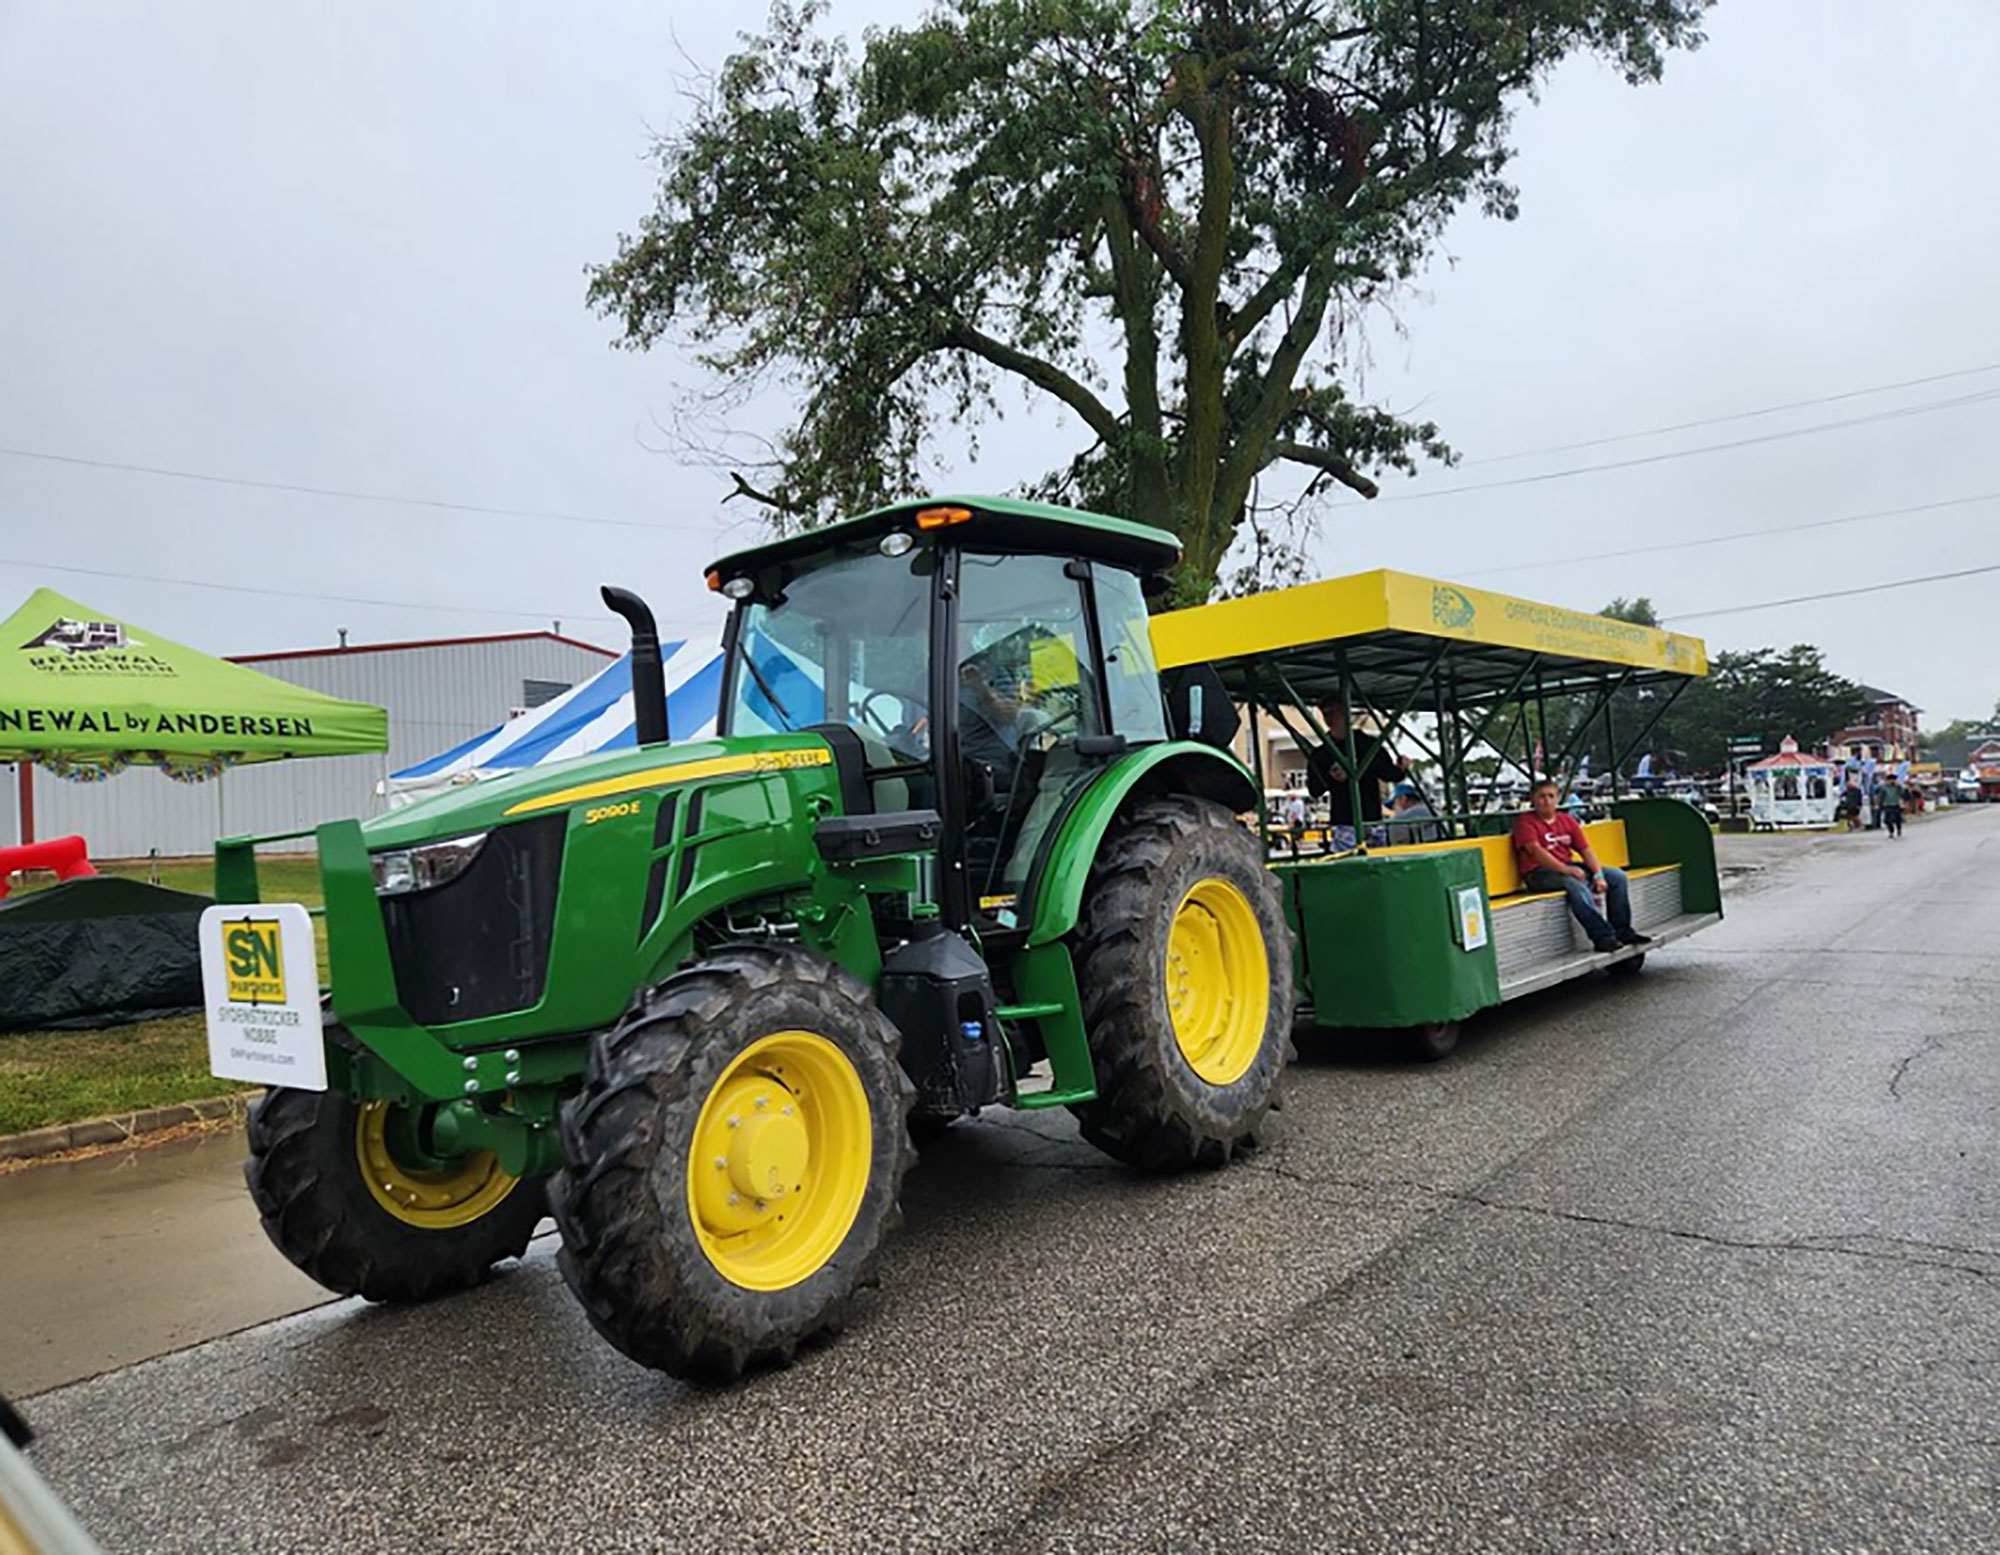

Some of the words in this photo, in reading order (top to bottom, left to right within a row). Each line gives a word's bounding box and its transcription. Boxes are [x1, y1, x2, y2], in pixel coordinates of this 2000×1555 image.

[0, 709, 119, 733] NEWAL
[126, 711, 150, 734] by
[156, 713, 313, 737] ANDERSEN
[231, 981, 281, 996] PARTNERS
